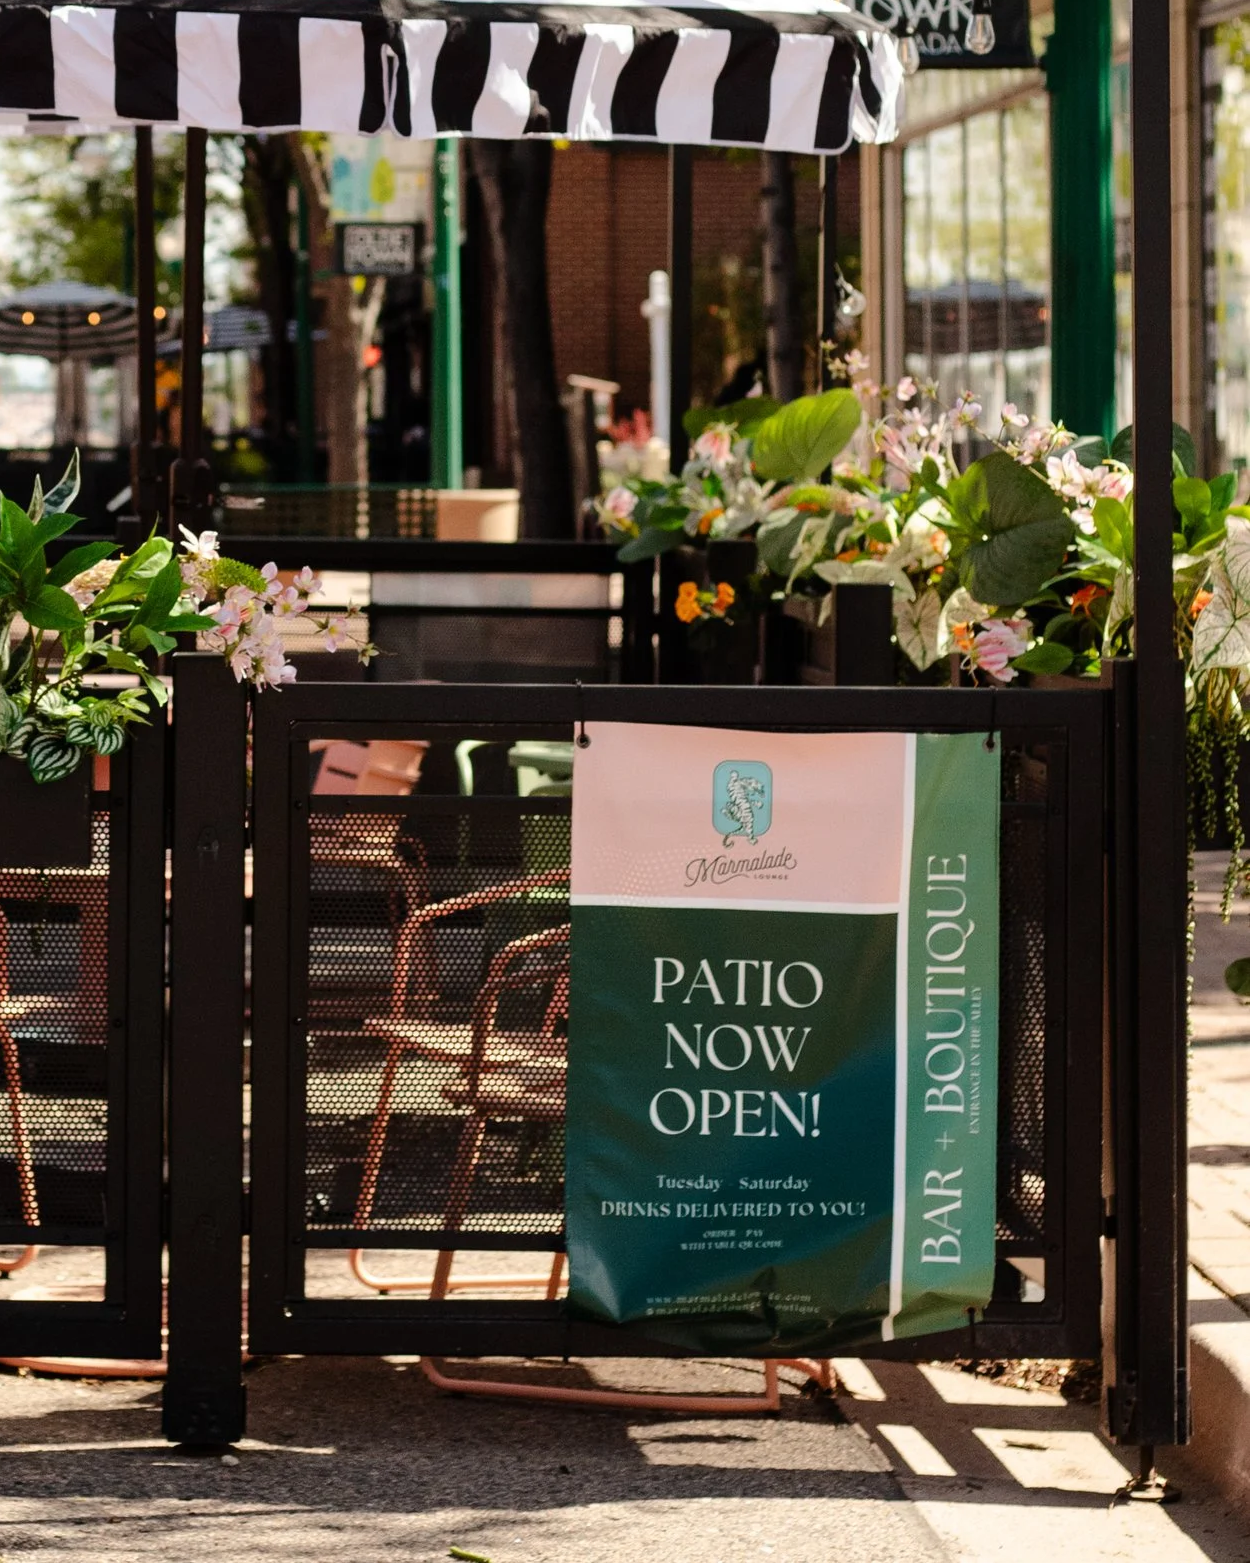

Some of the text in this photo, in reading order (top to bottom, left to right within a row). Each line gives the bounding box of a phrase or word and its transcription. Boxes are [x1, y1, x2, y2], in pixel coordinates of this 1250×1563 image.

[684, 846, 798, 887] Marmalade
[753, 873, 789, 881] LOUNGE
[652, 957, 824, 1009] PATIO
[664, 1022, 812, 1072] NOW
[969, 1025, 982, 1049] THE
[921, 853, 976, 1265] BAR + BOUTIQUE
[969, 1053, 982, 1067] IN
[648, 1088, 821, 1138] OPEN!
[969, 1070, 982, 1135] ENTRANCE
[656, 1174, 723, 1192] Tuesday
[739, 1175, 812, 1192] Saturday
[600, 1200, 866, 1218] DRINKS DELIVERED TO YOU!
